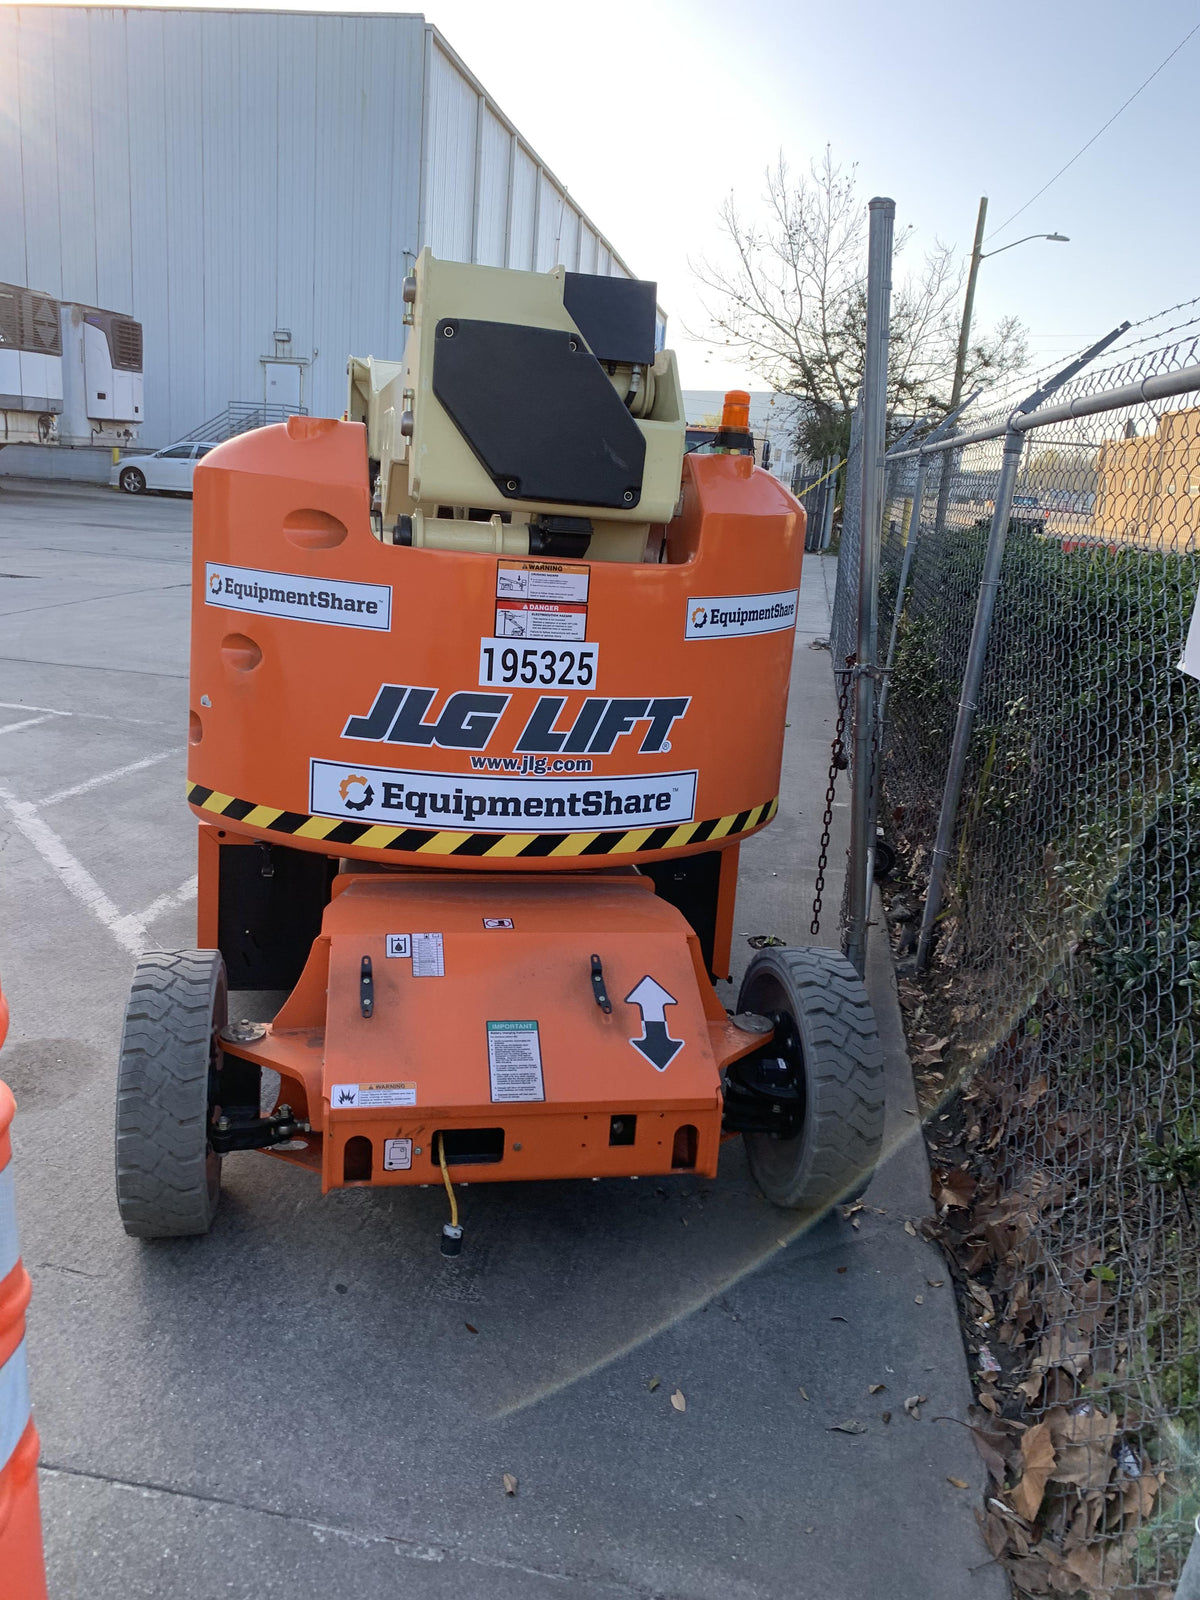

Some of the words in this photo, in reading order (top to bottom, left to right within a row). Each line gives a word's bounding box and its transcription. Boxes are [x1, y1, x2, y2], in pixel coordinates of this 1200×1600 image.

[529, 564, 563, 572] WARNING
[224, 577, 378, 615] EquipmentShare
[529, 604, 559, 612] DANGER
[709, 603, 795, 628] EquipmentShare
[483, 647, 594, 686] 195325
[341, 683, 512, 751] JLG
[513, 696, 692, 754] LIFT
[470, 755, 593, 775] www.jlg.com
[381, 782, 672, 821] EquipmentShare
